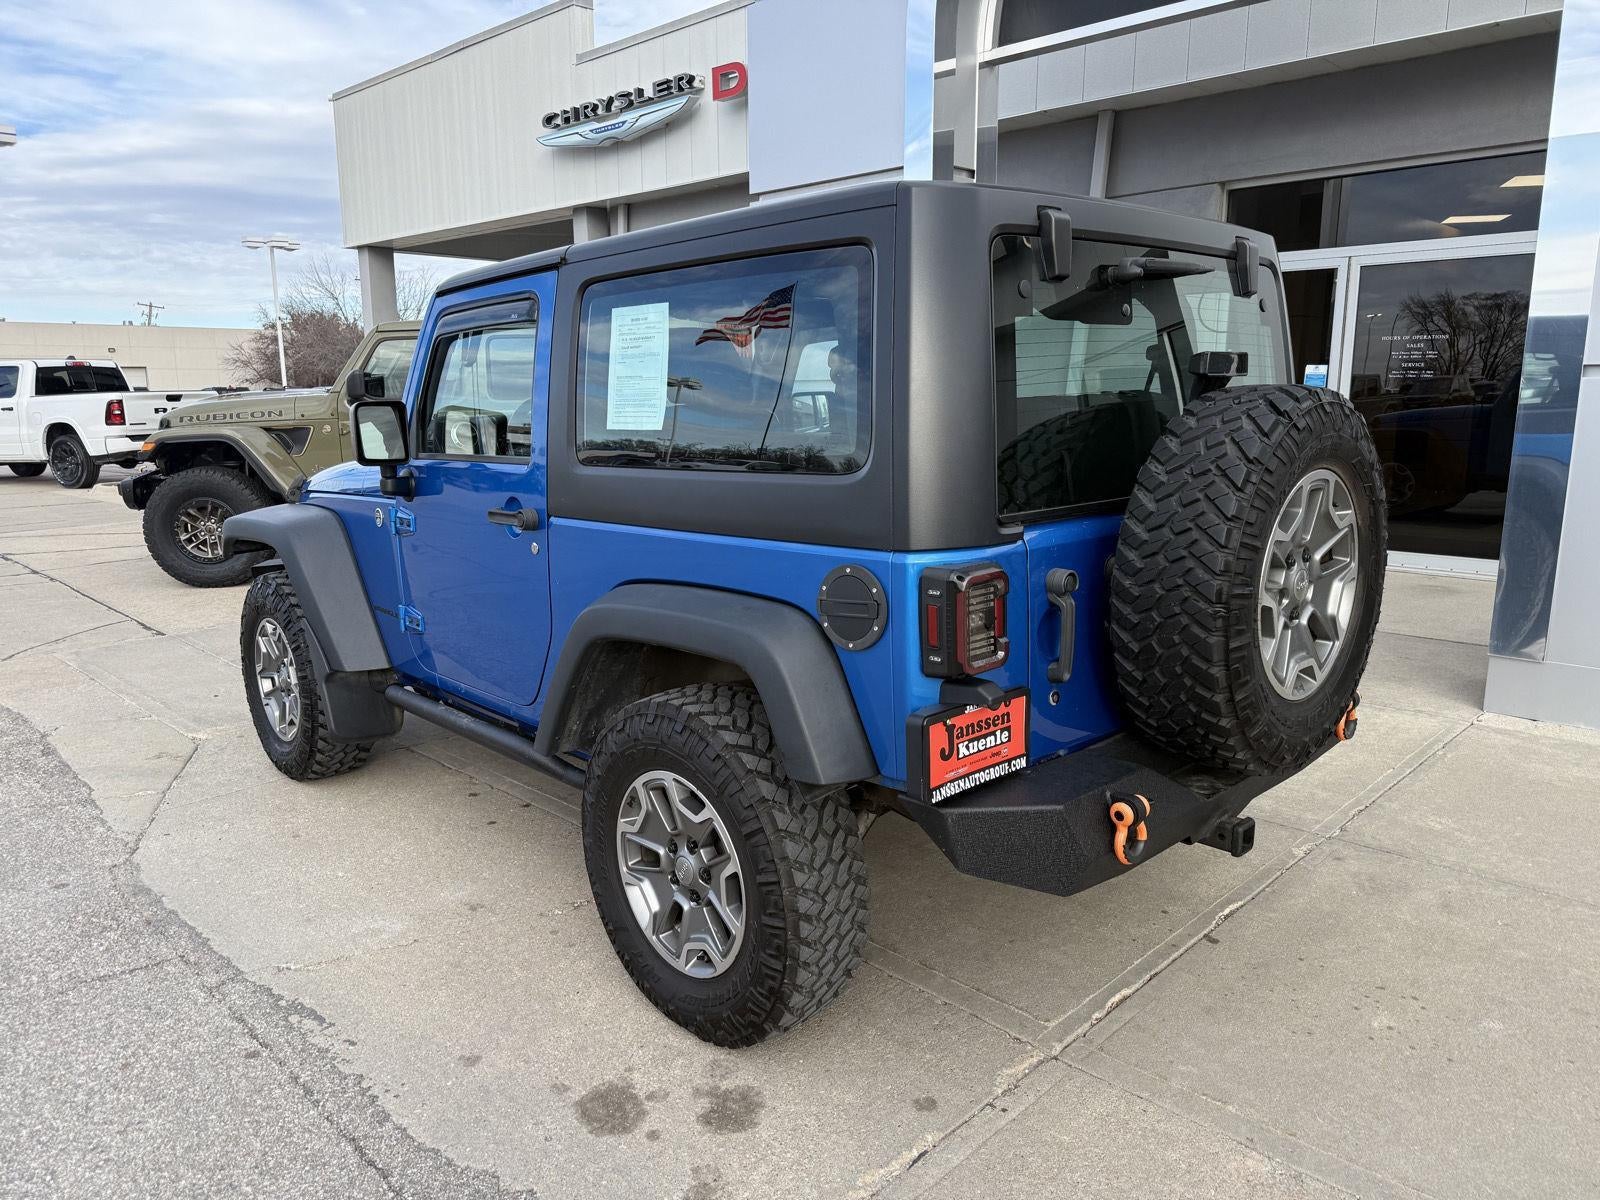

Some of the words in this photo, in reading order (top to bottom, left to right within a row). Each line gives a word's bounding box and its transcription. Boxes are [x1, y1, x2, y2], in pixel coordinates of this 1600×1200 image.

[541, 72, 697, 129] CHRYSLER
[711, 61, 748, 102] D
[178, 409, 284, 424] RUBICON
[939, 711, 1011, 761] Janssen
[957, 729, 1009, 759] Kuenle
